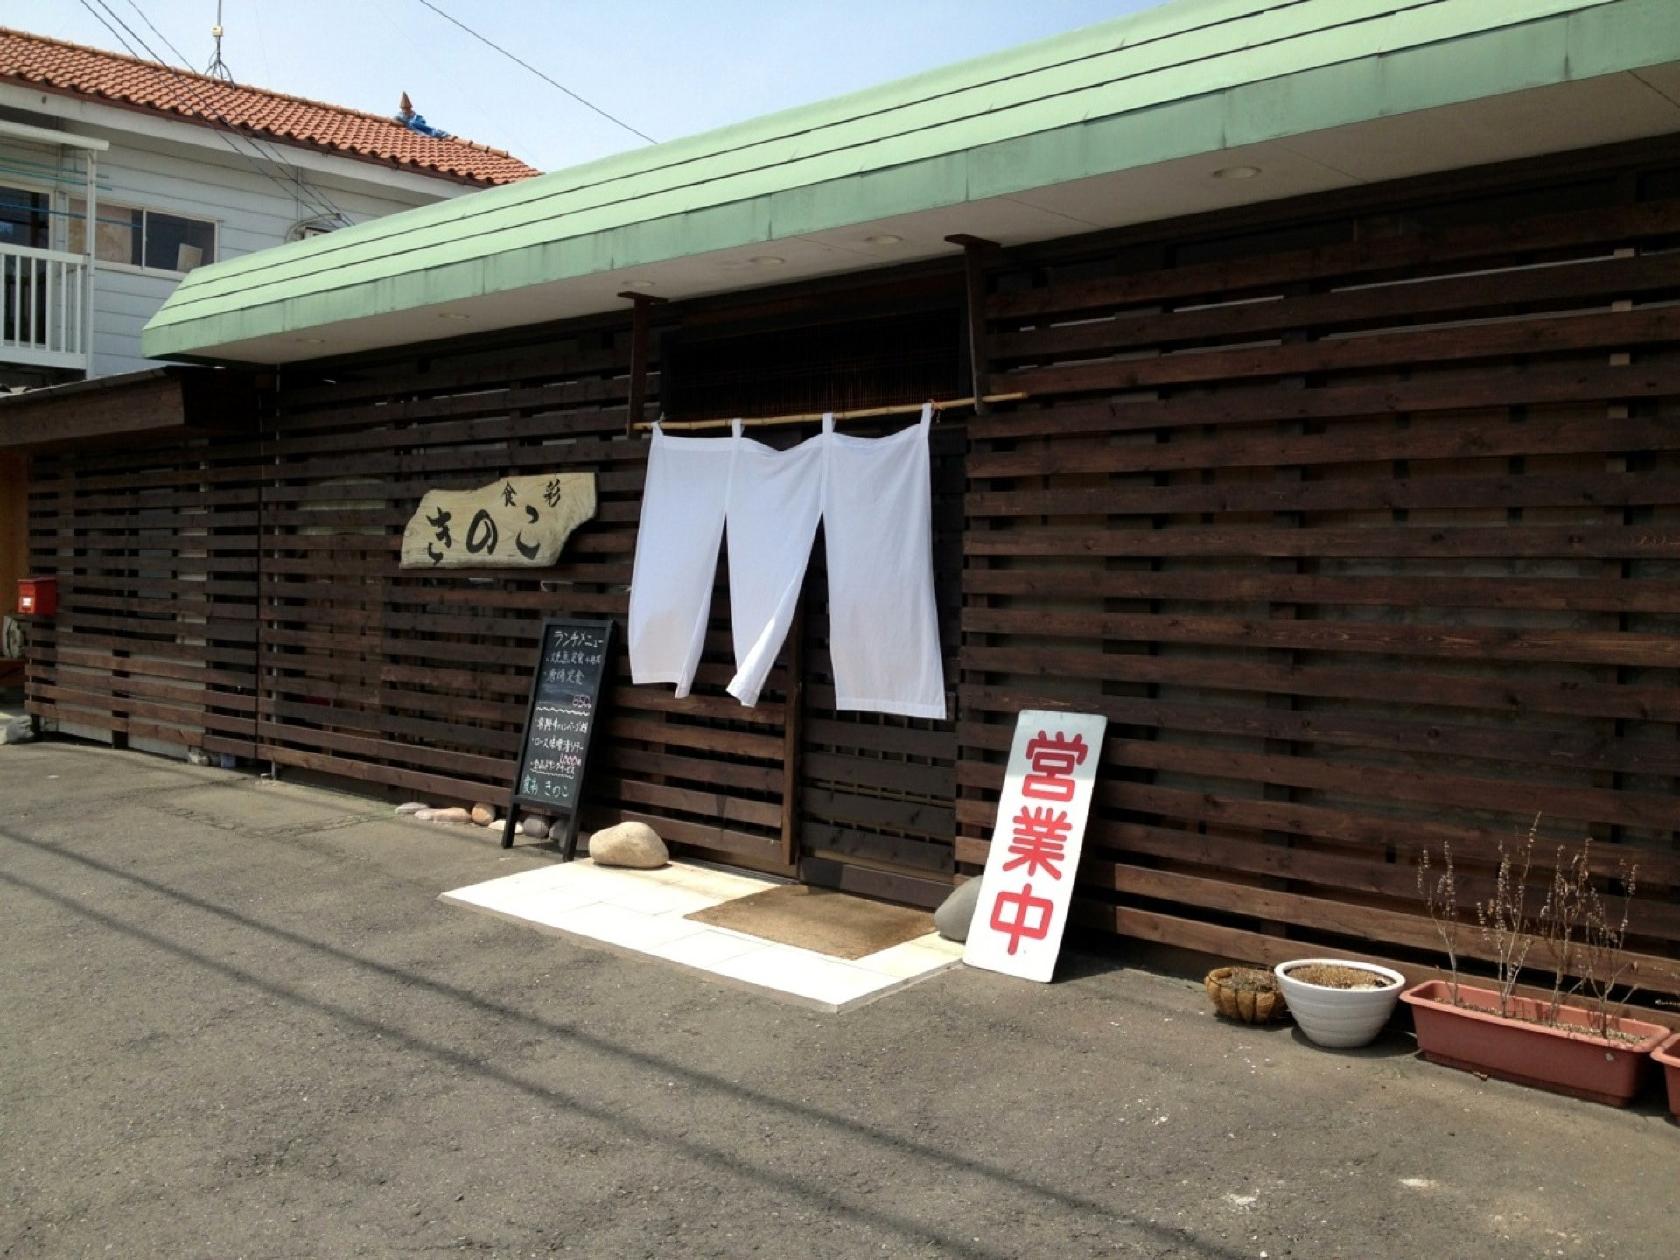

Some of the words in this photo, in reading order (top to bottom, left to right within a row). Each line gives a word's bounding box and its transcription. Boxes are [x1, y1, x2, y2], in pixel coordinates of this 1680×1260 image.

[502, 479, 561, 508] 食彩
[425, 506, 542, 566] きのこ
[553, 631, 604, 648] ランチメニュー
[989, 730, 1089, 956] 営業中
